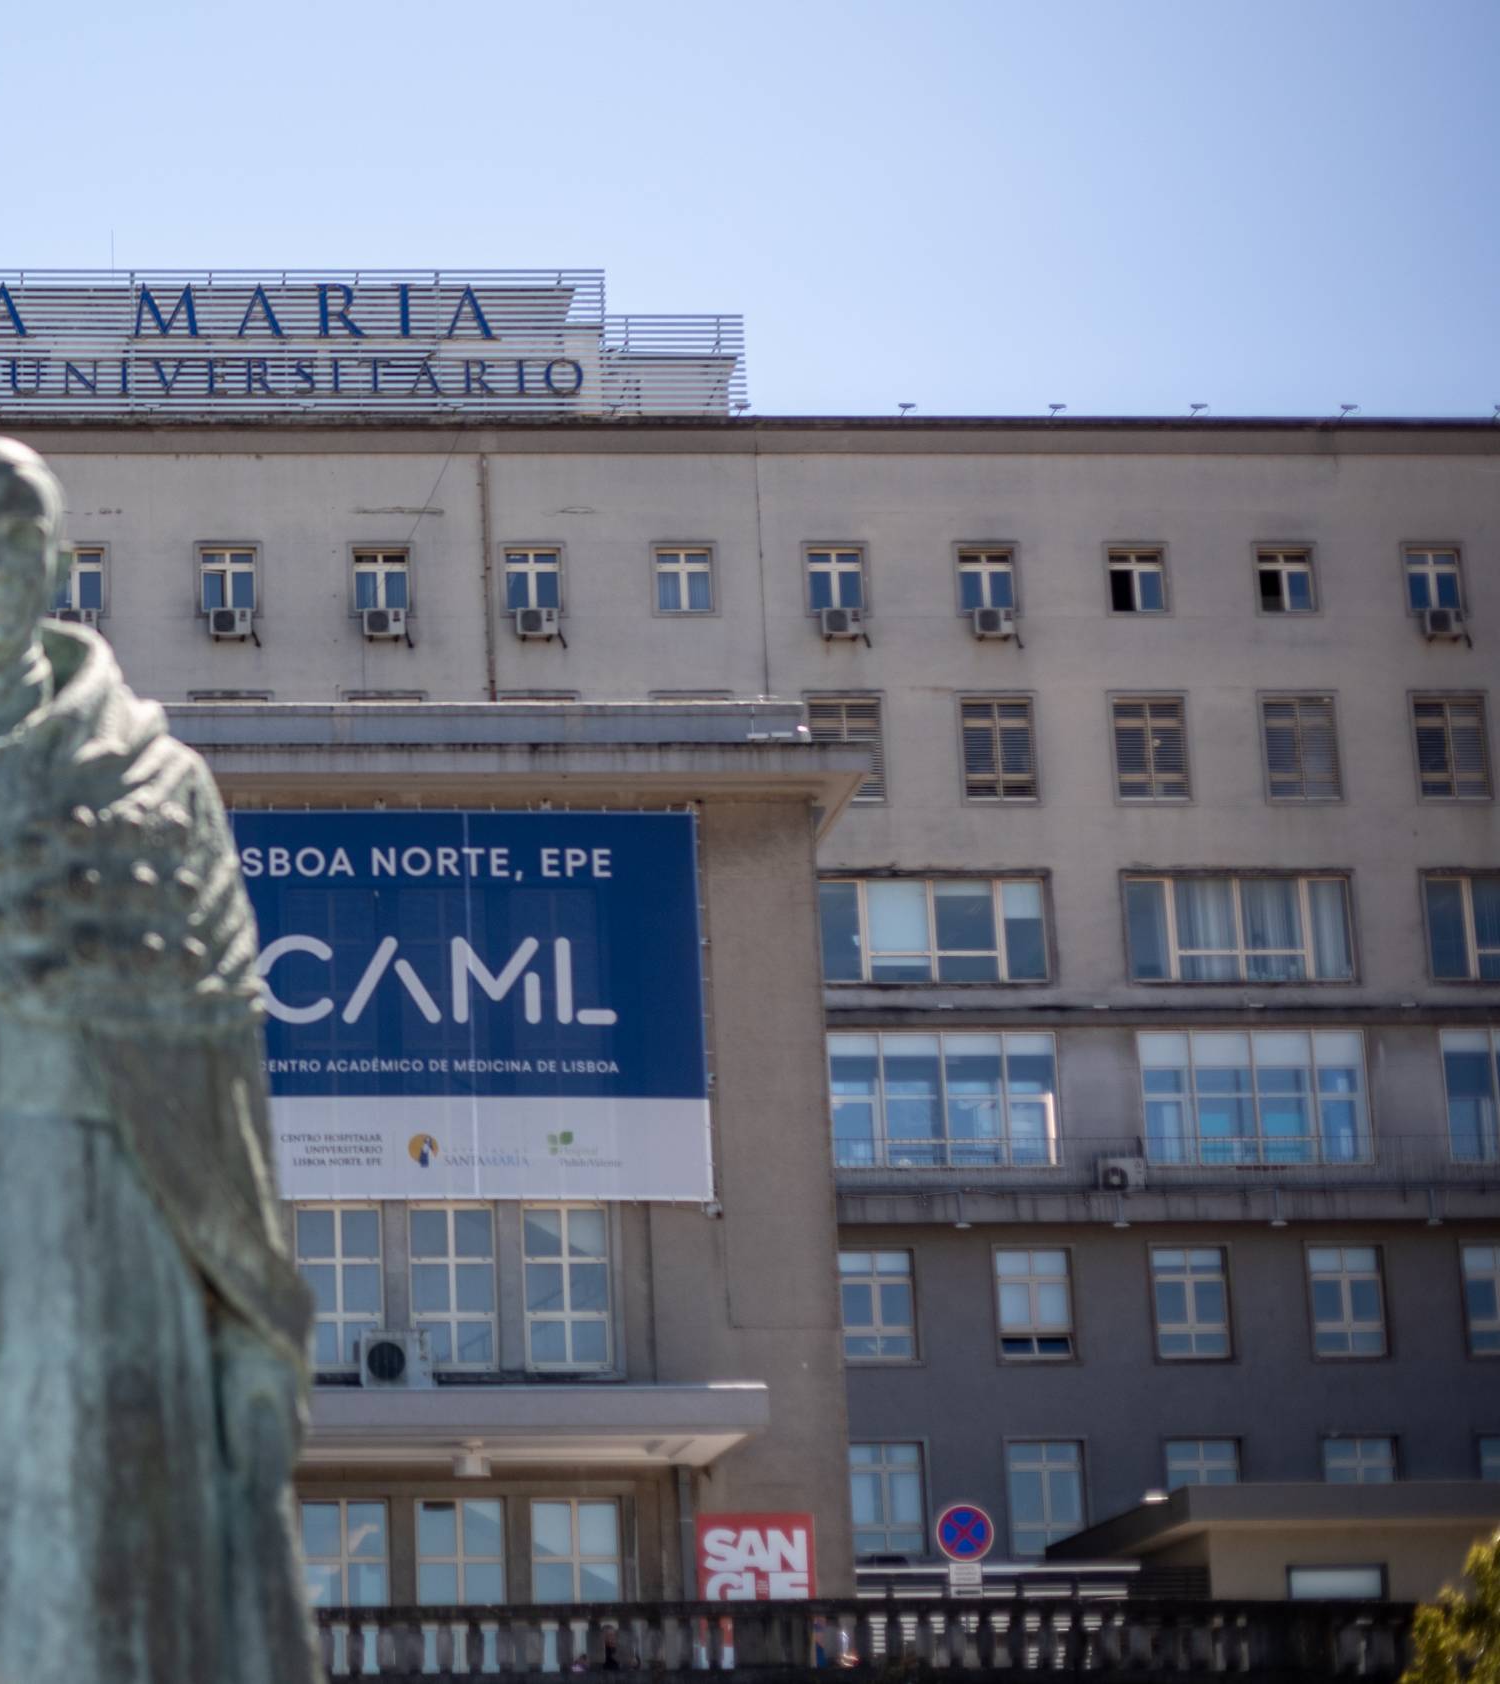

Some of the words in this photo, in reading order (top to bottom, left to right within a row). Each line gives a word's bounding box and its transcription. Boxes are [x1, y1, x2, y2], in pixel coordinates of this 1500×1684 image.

[130, 281, 500, 340] MARIA
[5, 352, 585, 396] UNIVERSITÁRIO
[240, 846, 355, 878] SBOA
[371, 847, 525, 881] NORTE,
[541, 848, 613, 878] EPE
[257, 934, 618, 1025] CAML
[326, 1055, 424, 1073] ACADÉMICO
[429, 1059, 448, 1073] DE
[453, 1059, 532, 1073] MEDICINA
[537, 1060, 556, 1073] DE
[562, 1060, 620, 1074] LISBOA
[704, 1527, 807, 1572] SAN
